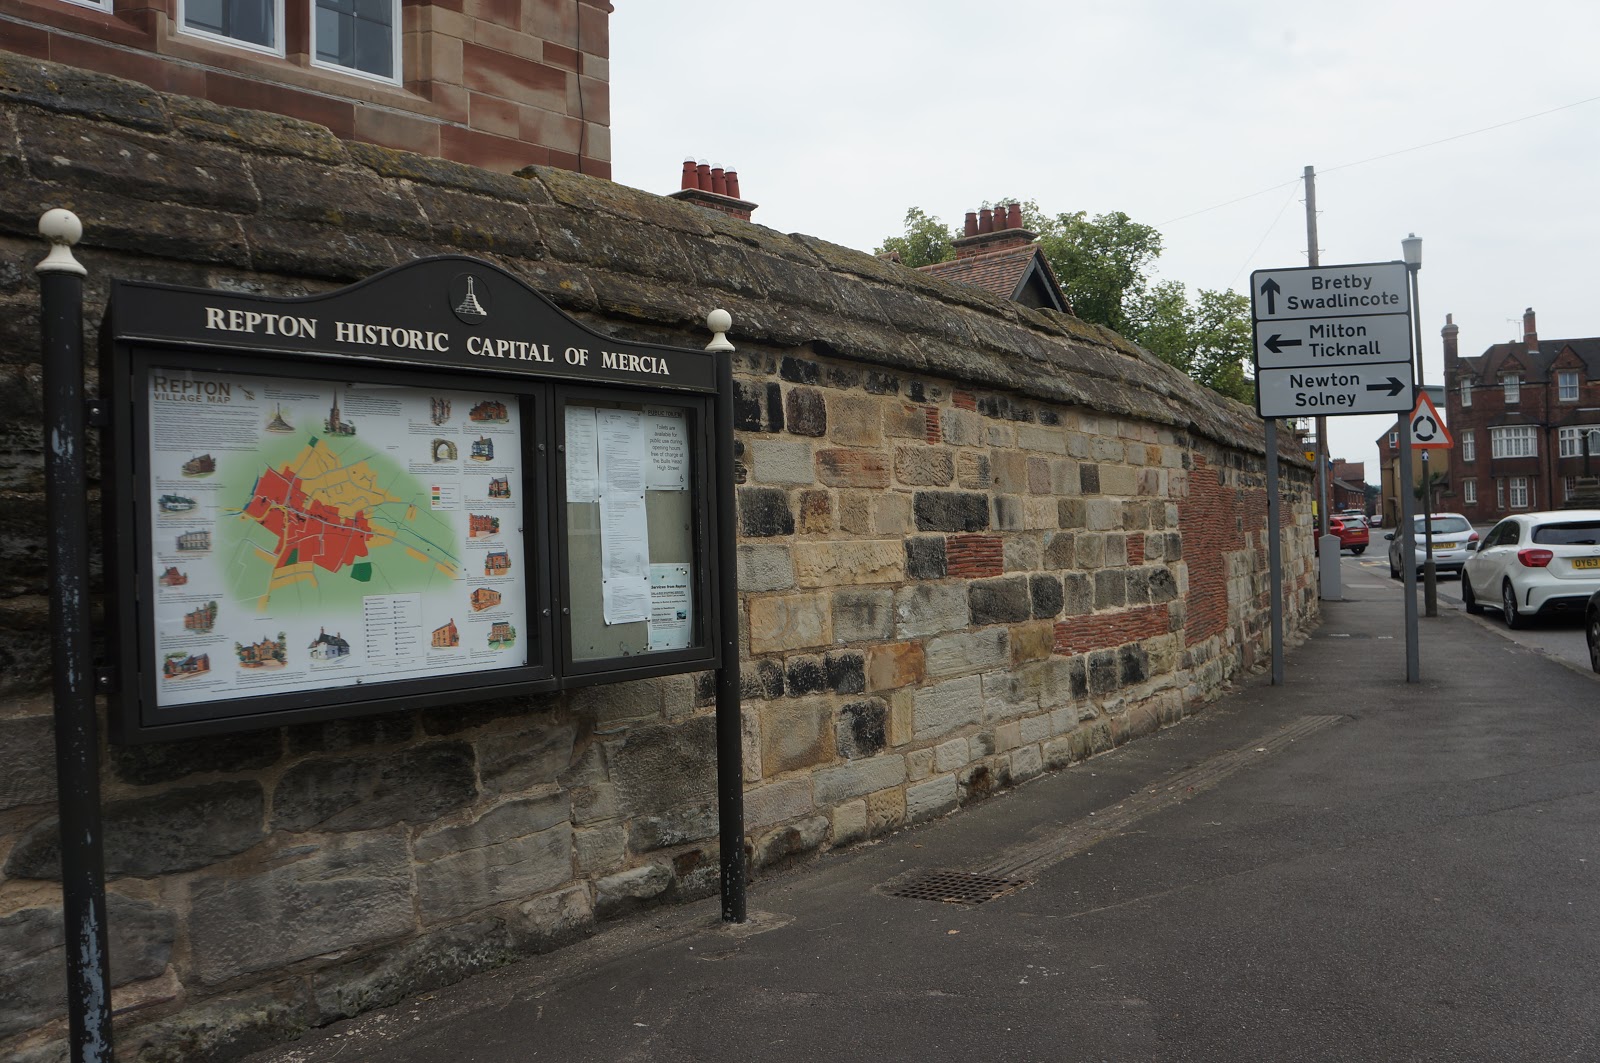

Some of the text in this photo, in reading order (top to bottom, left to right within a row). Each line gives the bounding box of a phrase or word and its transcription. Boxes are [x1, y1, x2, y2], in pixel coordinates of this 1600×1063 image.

[1311, 274, 1373, 292] Bretby
[1287, 291, 1400, 311] Swadlincote
[1309, 324, 1367, 339] Milton
[204, 307, 671, 376] REPTON HISTORIC CAPITAL OF MERCIA
[1308, 339, 1381, 358] Ticknall
[154, 375, 231, 397] REPTON
[1290, 373, 1360, 389] Newton
[154, 392, 231, 404] VILLAGE MAP
[1295, 391, 1356, 408] Solney
[1575, 559, 1598, 567] OY63
